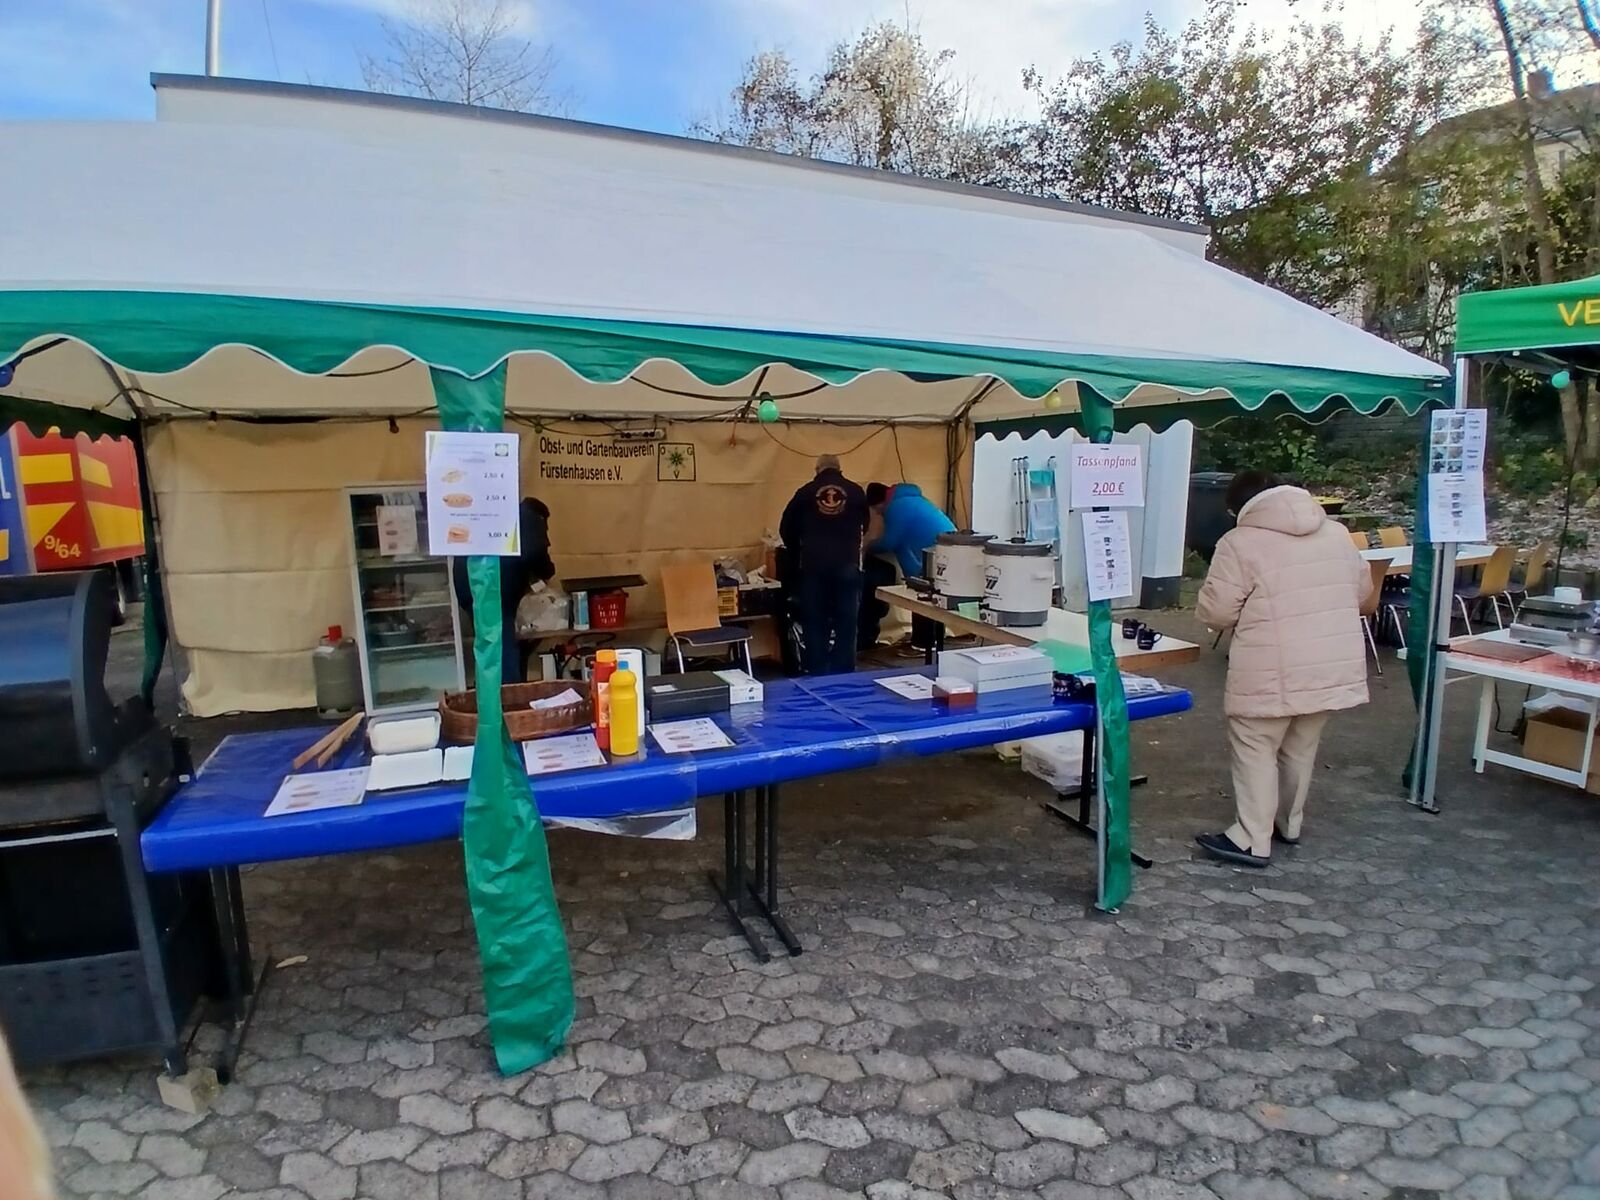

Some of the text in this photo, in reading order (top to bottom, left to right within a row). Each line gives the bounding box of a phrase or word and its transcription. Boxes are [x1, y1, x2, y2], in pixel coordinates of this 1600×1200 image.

[540, 436, 655, 458] Obst- und Gartenbauverein
[540, 461, 623, 481] Fürstenhausen e.V.
[1092, 482, 1125, 496] 2,00 €
[44, 535, 82, 559] 9/64
